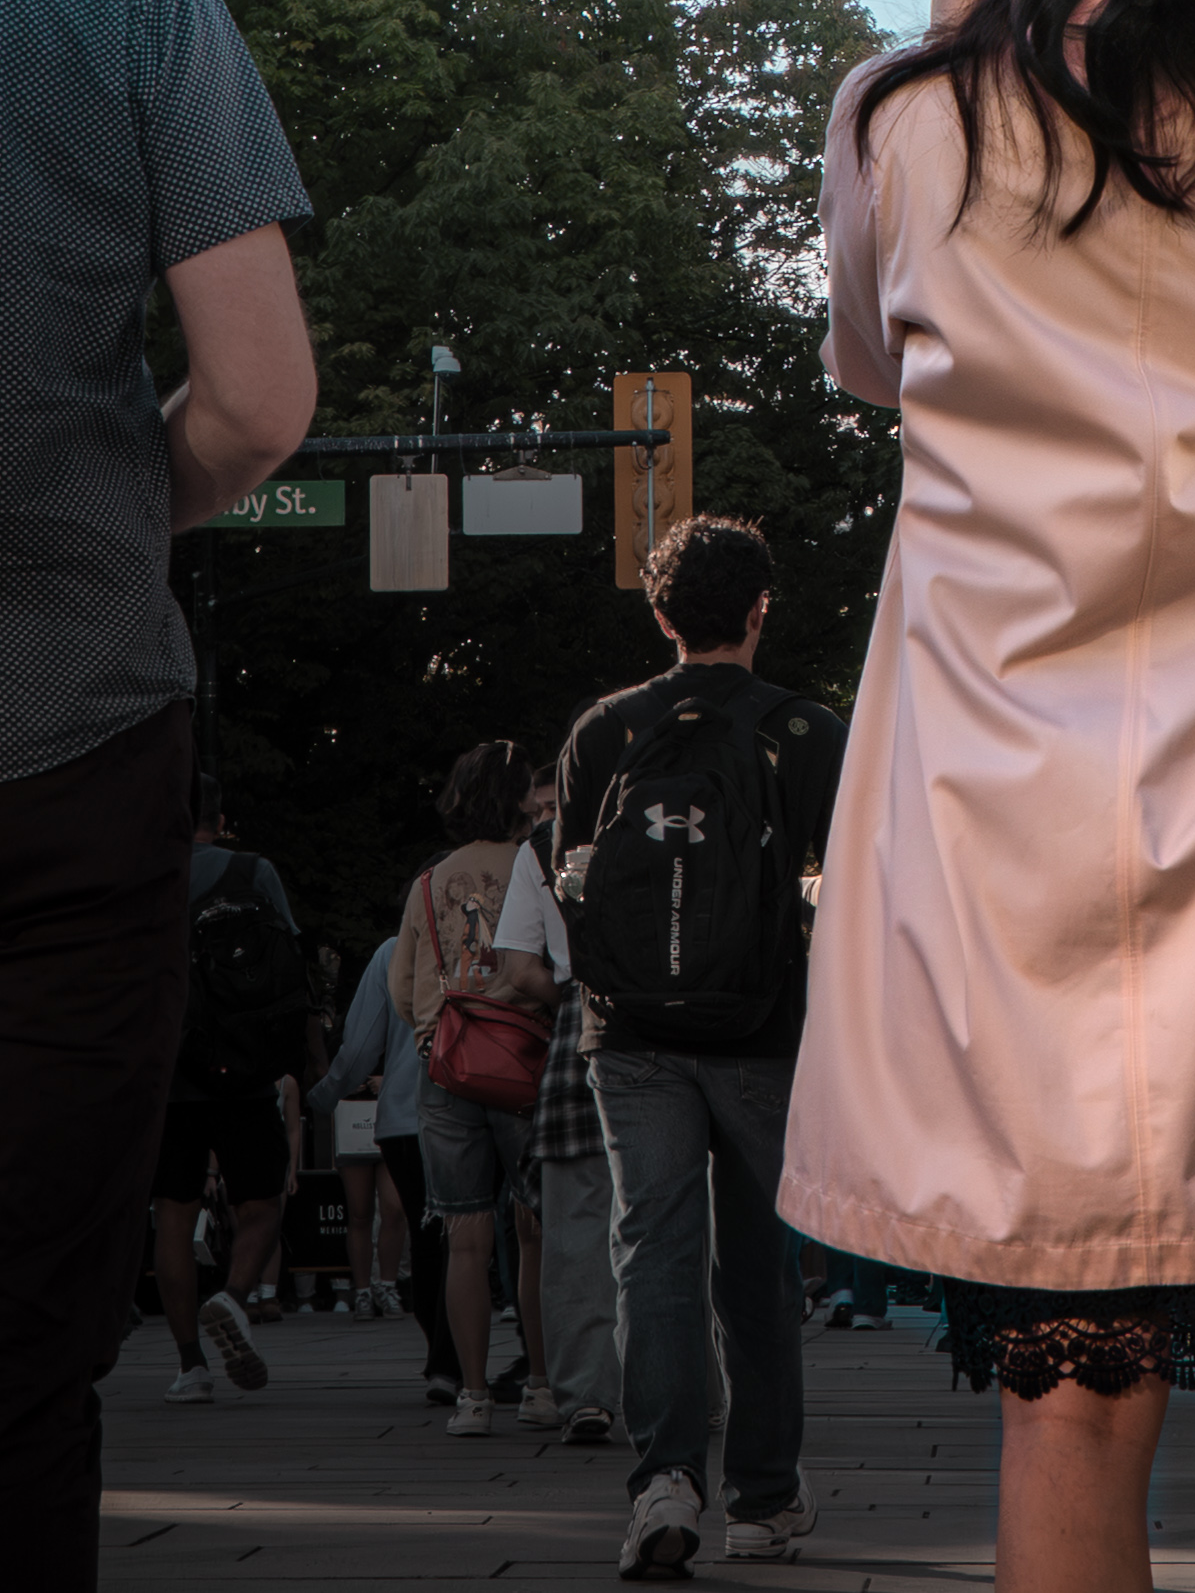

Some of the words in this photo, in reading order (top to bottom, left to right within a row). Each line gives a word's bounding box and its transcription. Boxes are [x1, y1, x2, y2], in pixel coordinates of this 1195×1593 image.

[223, 493, 268, 523] by
[275, 485, 317, 515] St.
[671, 857, 683, 909] UNDER
[670, 910, 681, 976] ARMOUR
[319, 1204, 345, 1221] LOS
